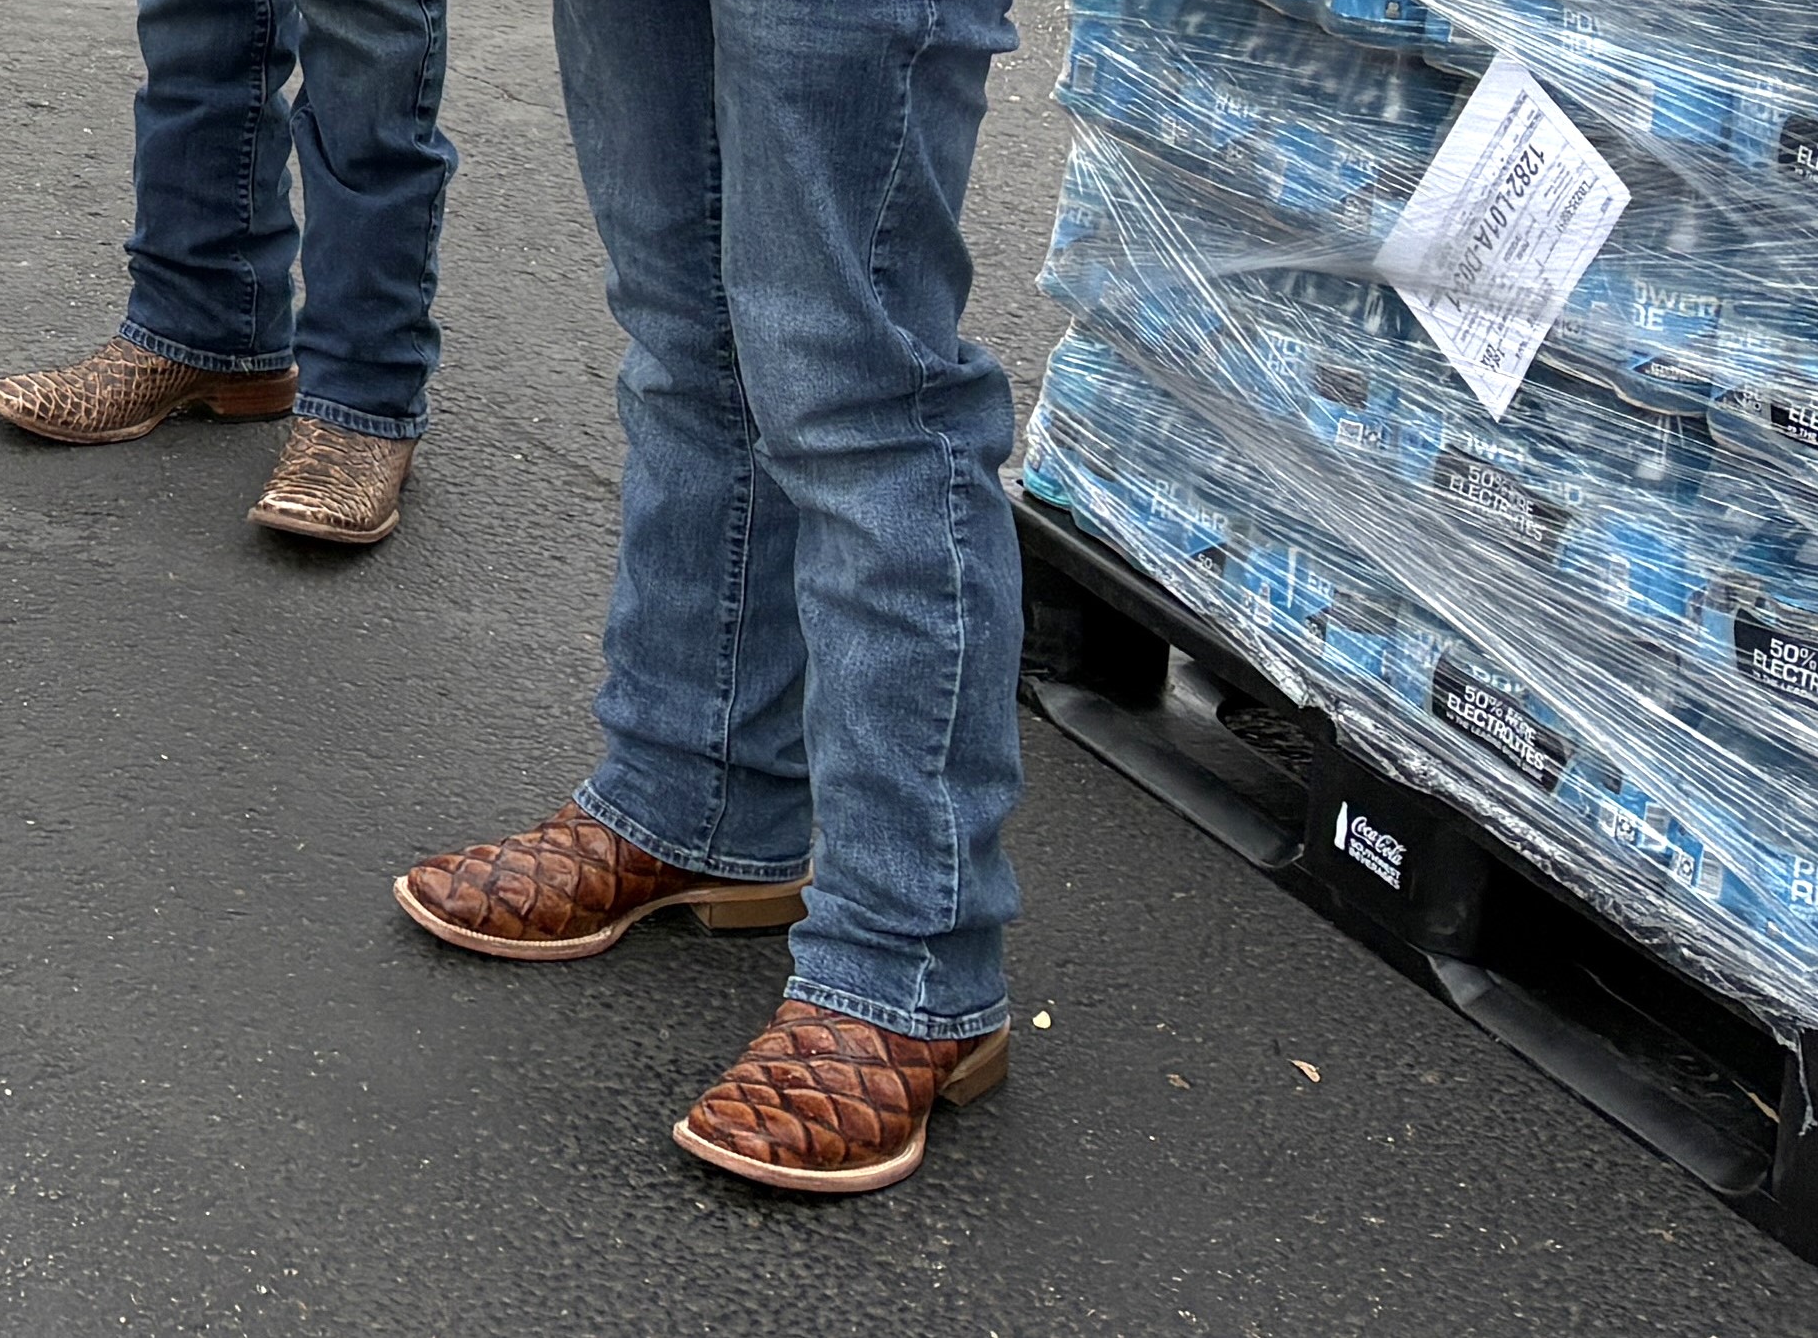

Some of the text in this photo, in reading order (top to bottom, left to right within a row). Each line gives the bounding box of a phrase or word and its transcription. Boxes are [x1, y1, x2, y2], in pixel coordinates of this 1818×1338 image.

[1506, 487, 1534, 517] RE
[1769, 637, 1818, 672] 50%
[1463, 684, 1505, 718] 50%
[1350, 815, 1408, 867] Coca-Cola
